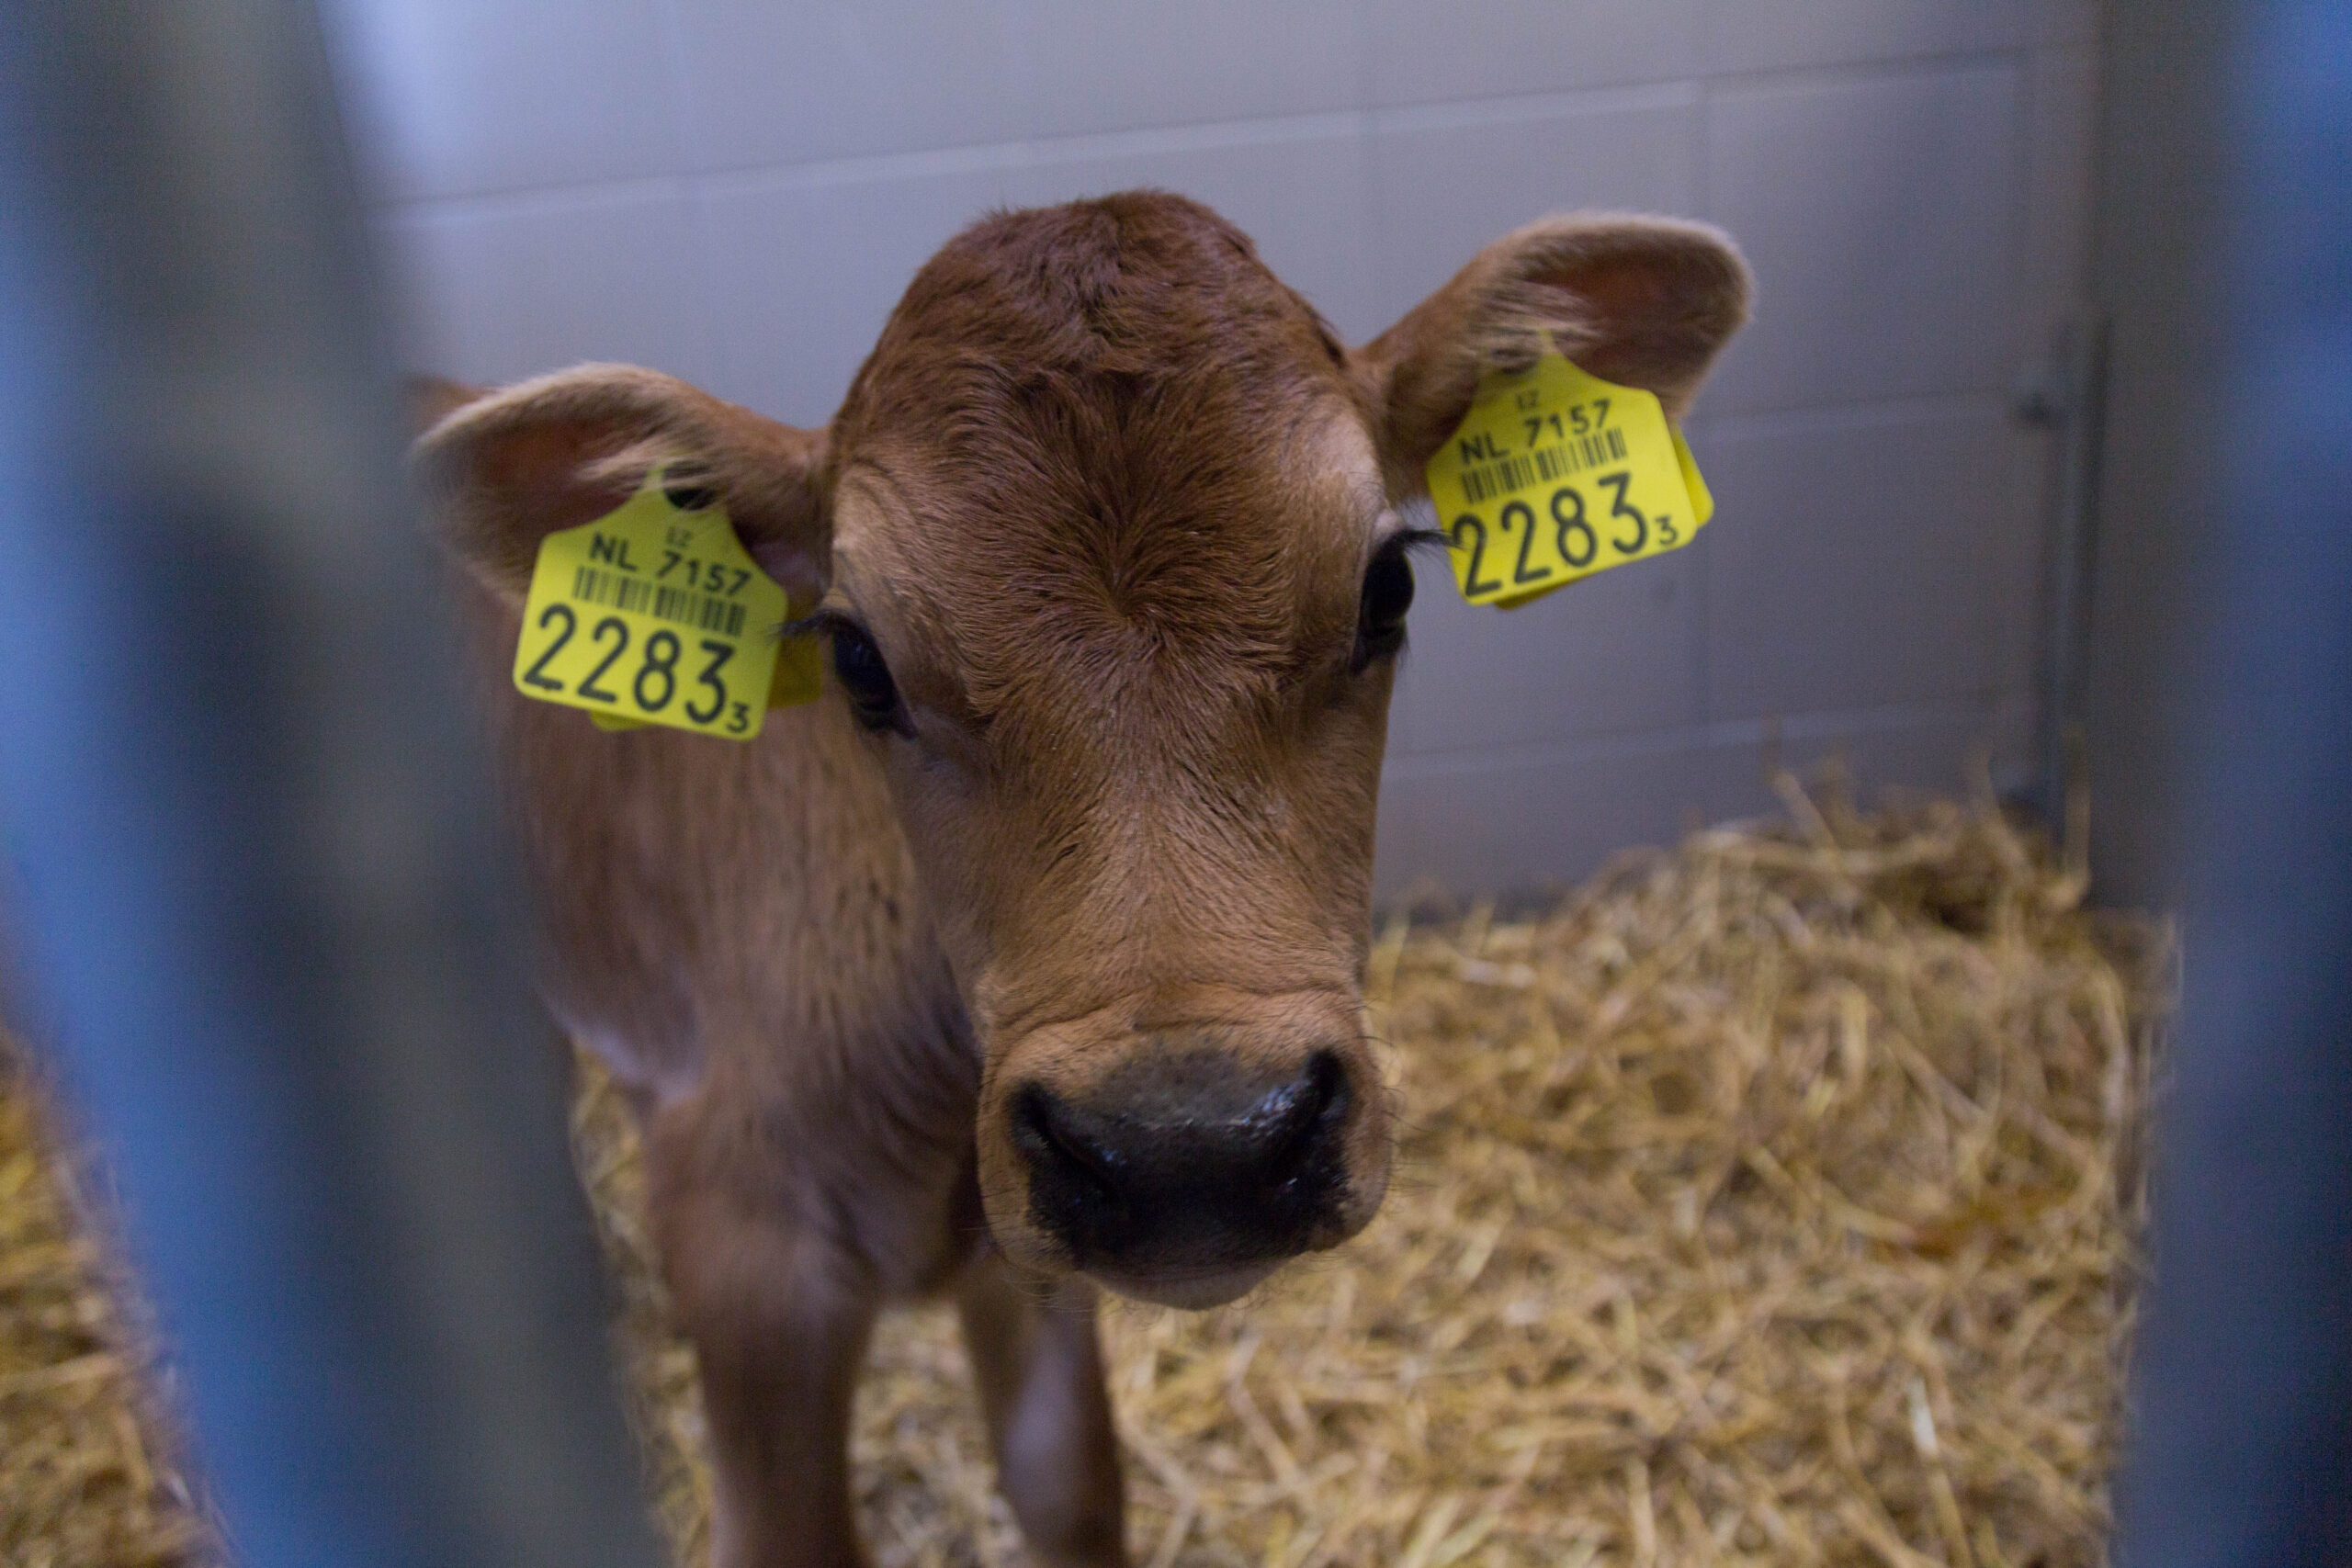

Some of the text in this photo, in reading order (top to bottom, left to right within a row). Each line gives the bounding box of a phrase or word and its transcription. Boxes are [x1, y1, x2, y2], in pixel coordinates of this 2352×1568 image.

[1459, 399, 1611, 464] NL 7157
[589, 534, 752, 596] NL 7157
[1452, 471, 1678, 597] 2283 3
[523, 603, 751, 733] 2283 3
